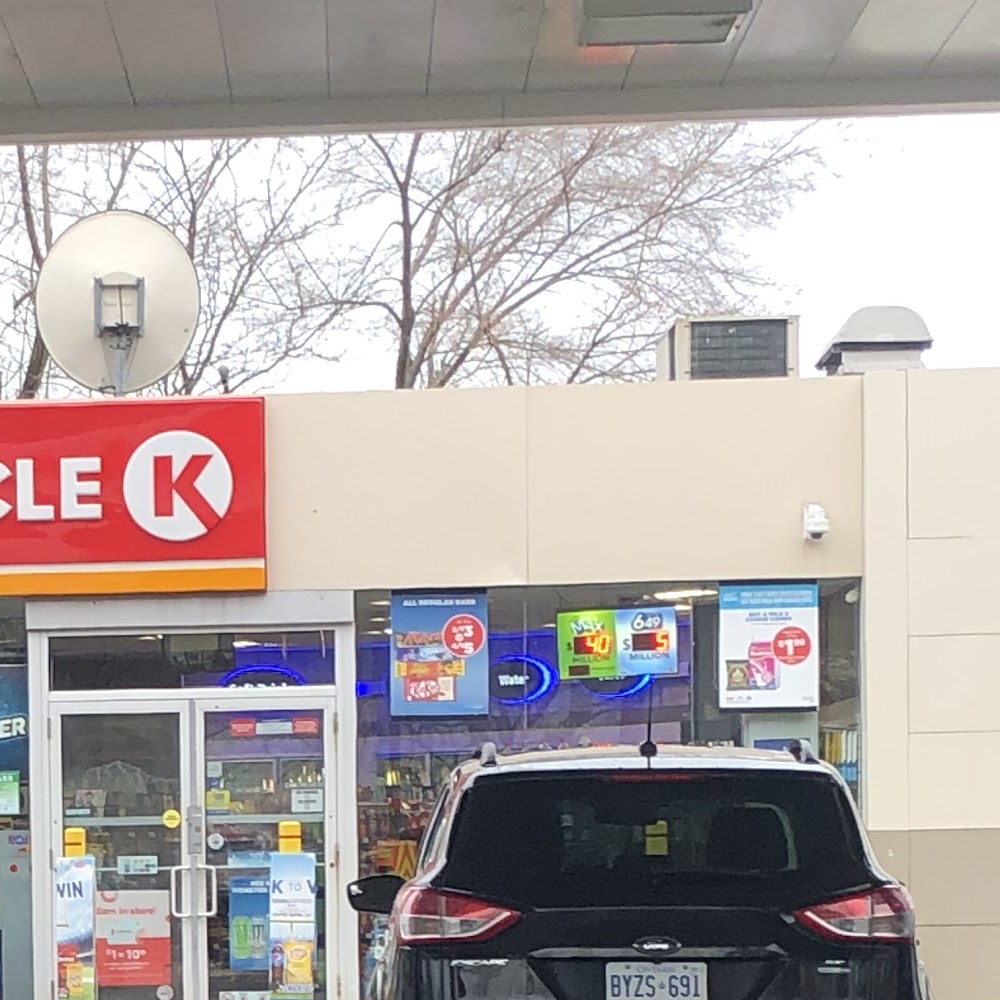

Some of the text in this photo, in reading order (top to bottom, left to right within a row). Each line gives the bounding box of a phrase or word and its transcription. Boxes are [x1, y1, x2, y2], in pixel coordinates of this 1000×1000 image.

[148, 450, 228, 537] K
[632, 614, 662, 630] 649
[585, 634, 612, 654] 40
[655, 630, 670, 653] 5
[630, 651, 670, 661] MILLION
[287, 883, 303, 892] TO
[610, 974, 700, 998] BYZS 691
